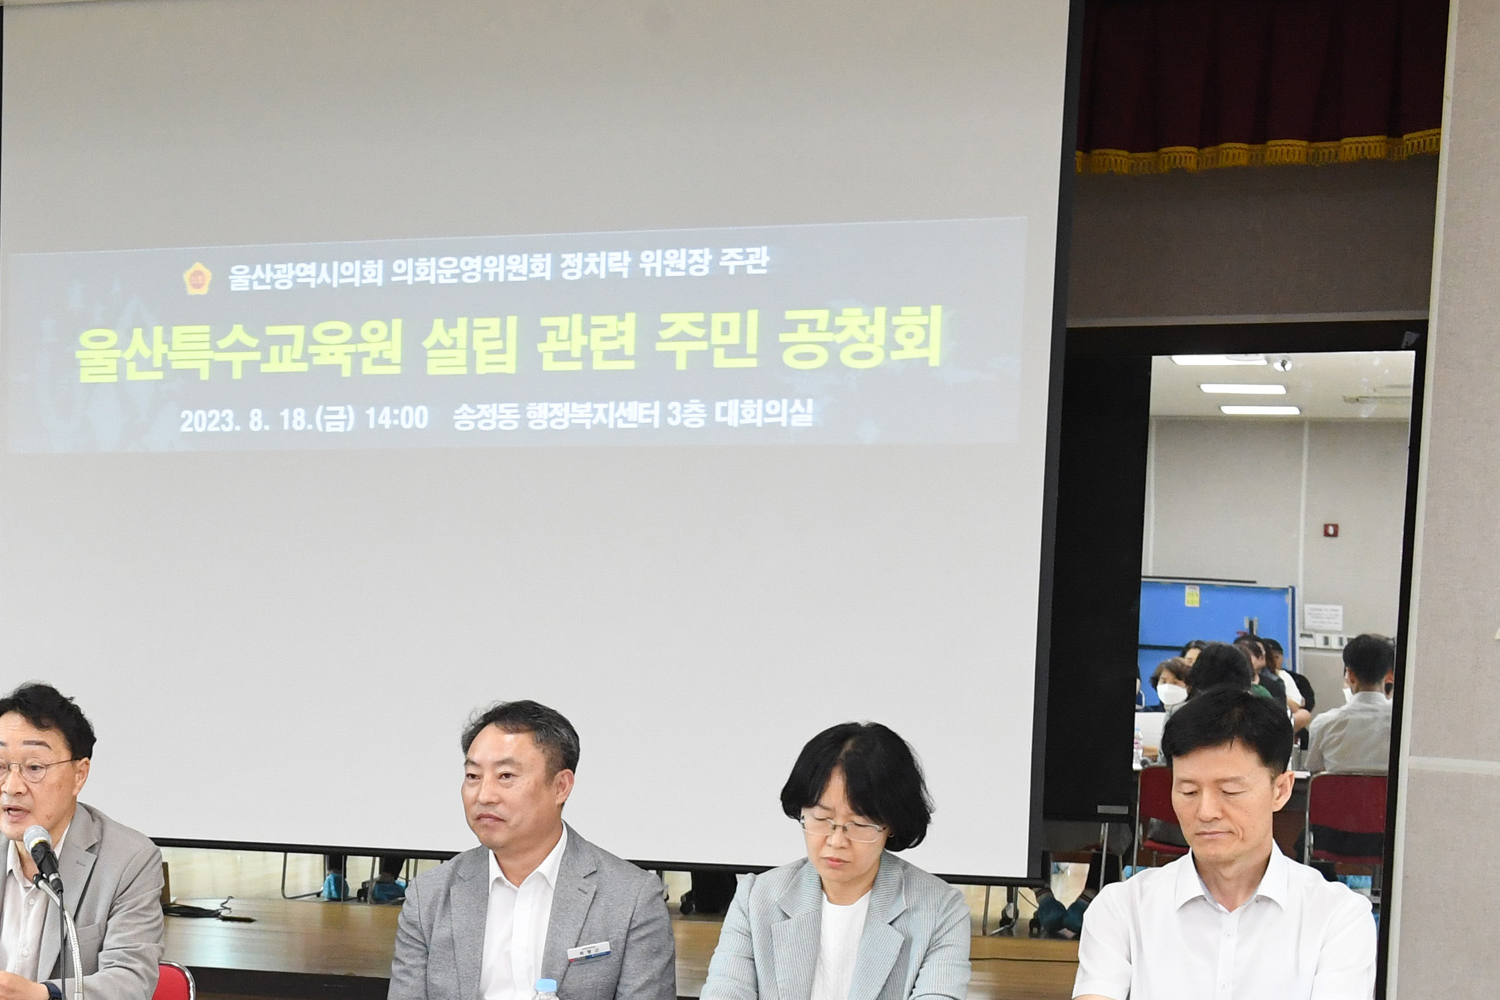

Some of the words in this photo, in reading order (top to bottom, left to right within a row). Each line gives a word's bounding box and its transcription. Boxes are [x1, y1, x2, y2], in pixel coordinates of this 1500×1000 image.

[228, 258, 384, 291] 울산광역시의회
[391, 252, 552, 285] 의회운영위원회
[559, 250, 632, 282] 정치락
[638, 247, 713, 279] 위원장
[718, 246, 770, 276] 주관
[75, 318, 402, 383] 울산특수교육원
[423, 315, 517, 375] 설립
[536, 312, 636, 372] 관련
[655, 309, 759, 370] 주민
[779, 304, 943, 371] 공청회
[180, 409, 241, 433] 2023.
[249, 408, 270, 432] 8.
[279, 405, 356, 433] 18.(금)
[365, 405, 429, 430] 14:00
[452, 403, 520, 432] 송정동
[526, 400, 660, 431] 행정복지센터
[667, 398, 708, 430] 3층
[715, 398, 814, 428] 대회의실
